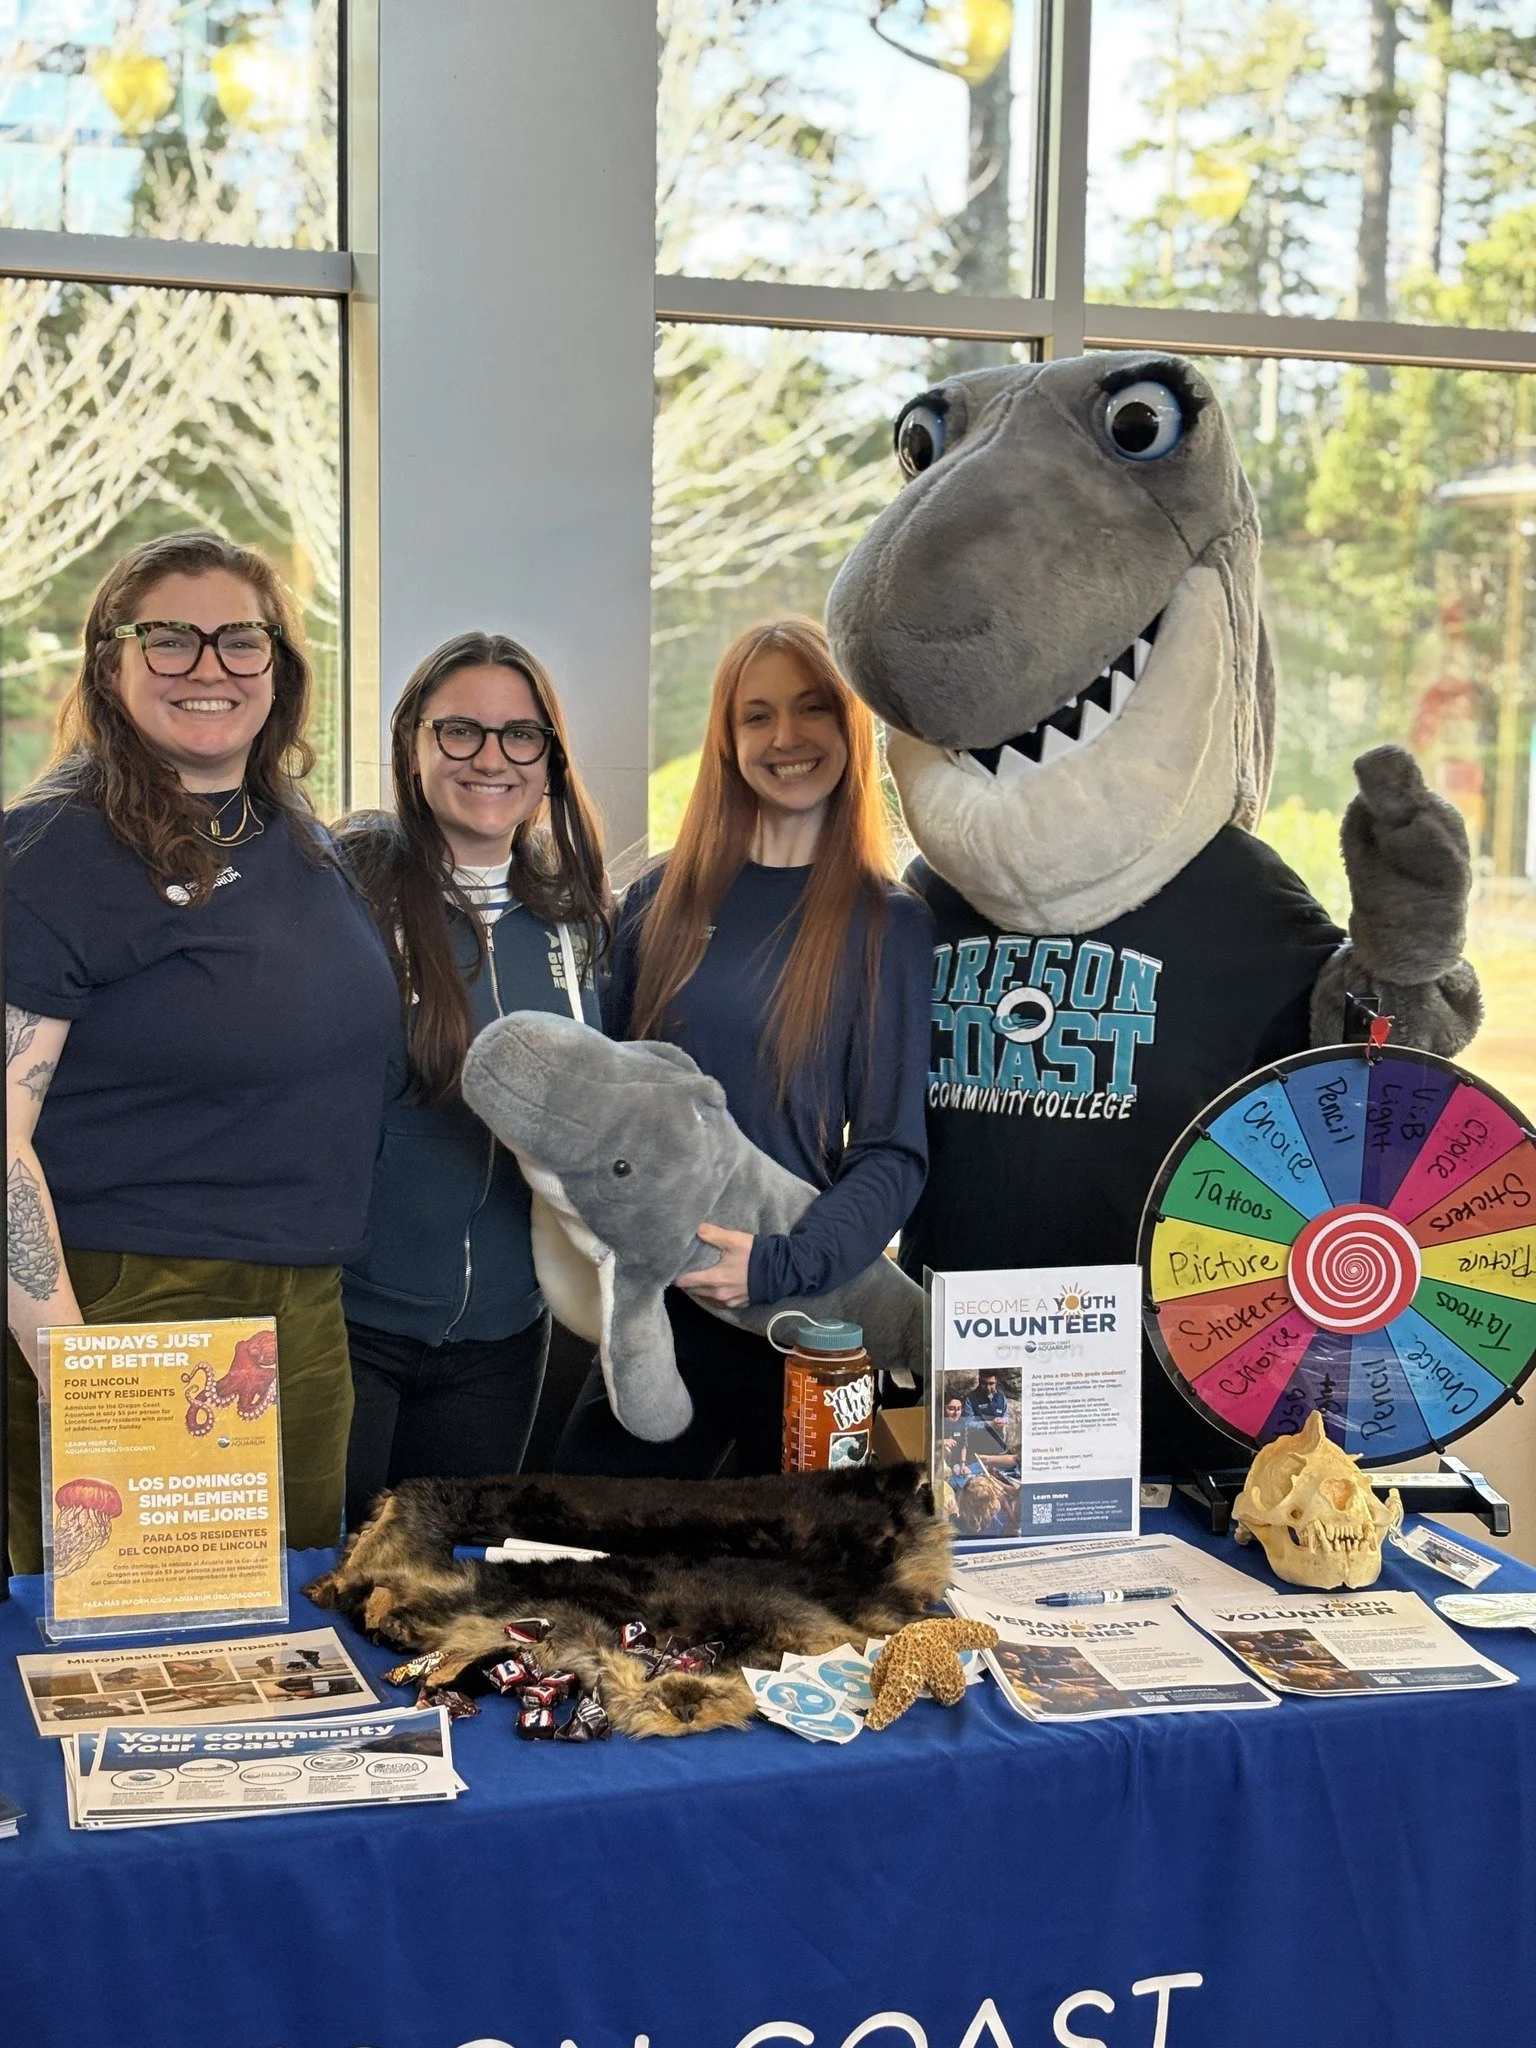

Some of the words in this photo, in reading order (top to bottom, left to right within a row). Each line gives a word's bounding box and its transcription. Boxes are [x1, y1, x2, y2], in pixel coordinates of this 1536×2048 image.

[929, 1082, 1030, 1115] COMMUNITY
[1034, 1091, 1137, 1120] COLLEGE
[1317, 1076, 1356, 1145] Pencil
[1367, 1084, 1402, 1153] Light
[1243, 1100, 1314, 1184] Choice
[1428, 1119, 1488, 1179] Choice
[1193, 1169, 1272, 1223] Tattoos
[1429, 1173, 1532, 1232] Stickers
[1169, 1251, 1278, 1286] Picture
[1458, 1244, 1533, 1278] Picture
[955, 1299, 1029, 1315] BECOME
[1036, 1300, 1048, 1311] A
[1054, 1295, 1115, 1311] YOUTH
[953, 1313, 1116, 1338] VOLUNTEER
[1179, 1292, 1288, 1352] Stickers
[1437, 1291, 1512, 1351] Tattoos
[64, 1335, 158, 1351] SUNDAYS
[163, 1333, 212, 1348] JUST
[64, 1355, 106, 1370] GOT
[112, 1352, 189, 1368] BETTER
[1220, 1326, 1299, 1396] Choice
[64, 1379, 87, 1387] FOR
[91, 1377, 139, 1387] LINCOLN
[1407, 1340, 1480, 1414] Choice
[65, 1391, 111, 1400] COUNTY
[115, 1389, 175, 1398] RESIDENTS
[1361, 1359, 1397, 1441] Pencil
[128, 1477, 164, 1491] LOS
[169, 1472, 268, 1490] DOMINGOS
[139, 1489, 268, 1508] SIMPLEMENTE
[139, 1511, 178, 1526] SON
[183, 1506, 269, 1523] MEJORES
[143, 1534, 172, 1543] PARA
[176, 1532, 197, 1540] LOS
[200, 1528, 267, 1539] RESIDENTES
[119, 1547, 139, 1556] DEL
[143, 1544, 199, 1555] CONDADO
[202, 1543, 217, 1551] DE
[220, 1540, 268, 1550] LINCOLN
[1095, 1619, 1160, 1630] PARA
[1215, 1607, 1396, 1622] VOLUNTEER
[1025, 1629, 1134, 1638] JOVENES
[67, 1652, 174, 1665] Microplastics,
[178, 1647, 223, 1657] Macro
[228, 1641, 288, 1652] Impacts
[119, 1732, 197, 1743] Your
[203, 1724, 395, 1742] community
[117, 1742, 195, 1754] Your
[203, 1739, 294, 1751] coast
[737, 1972, 1203, 2048] AST
